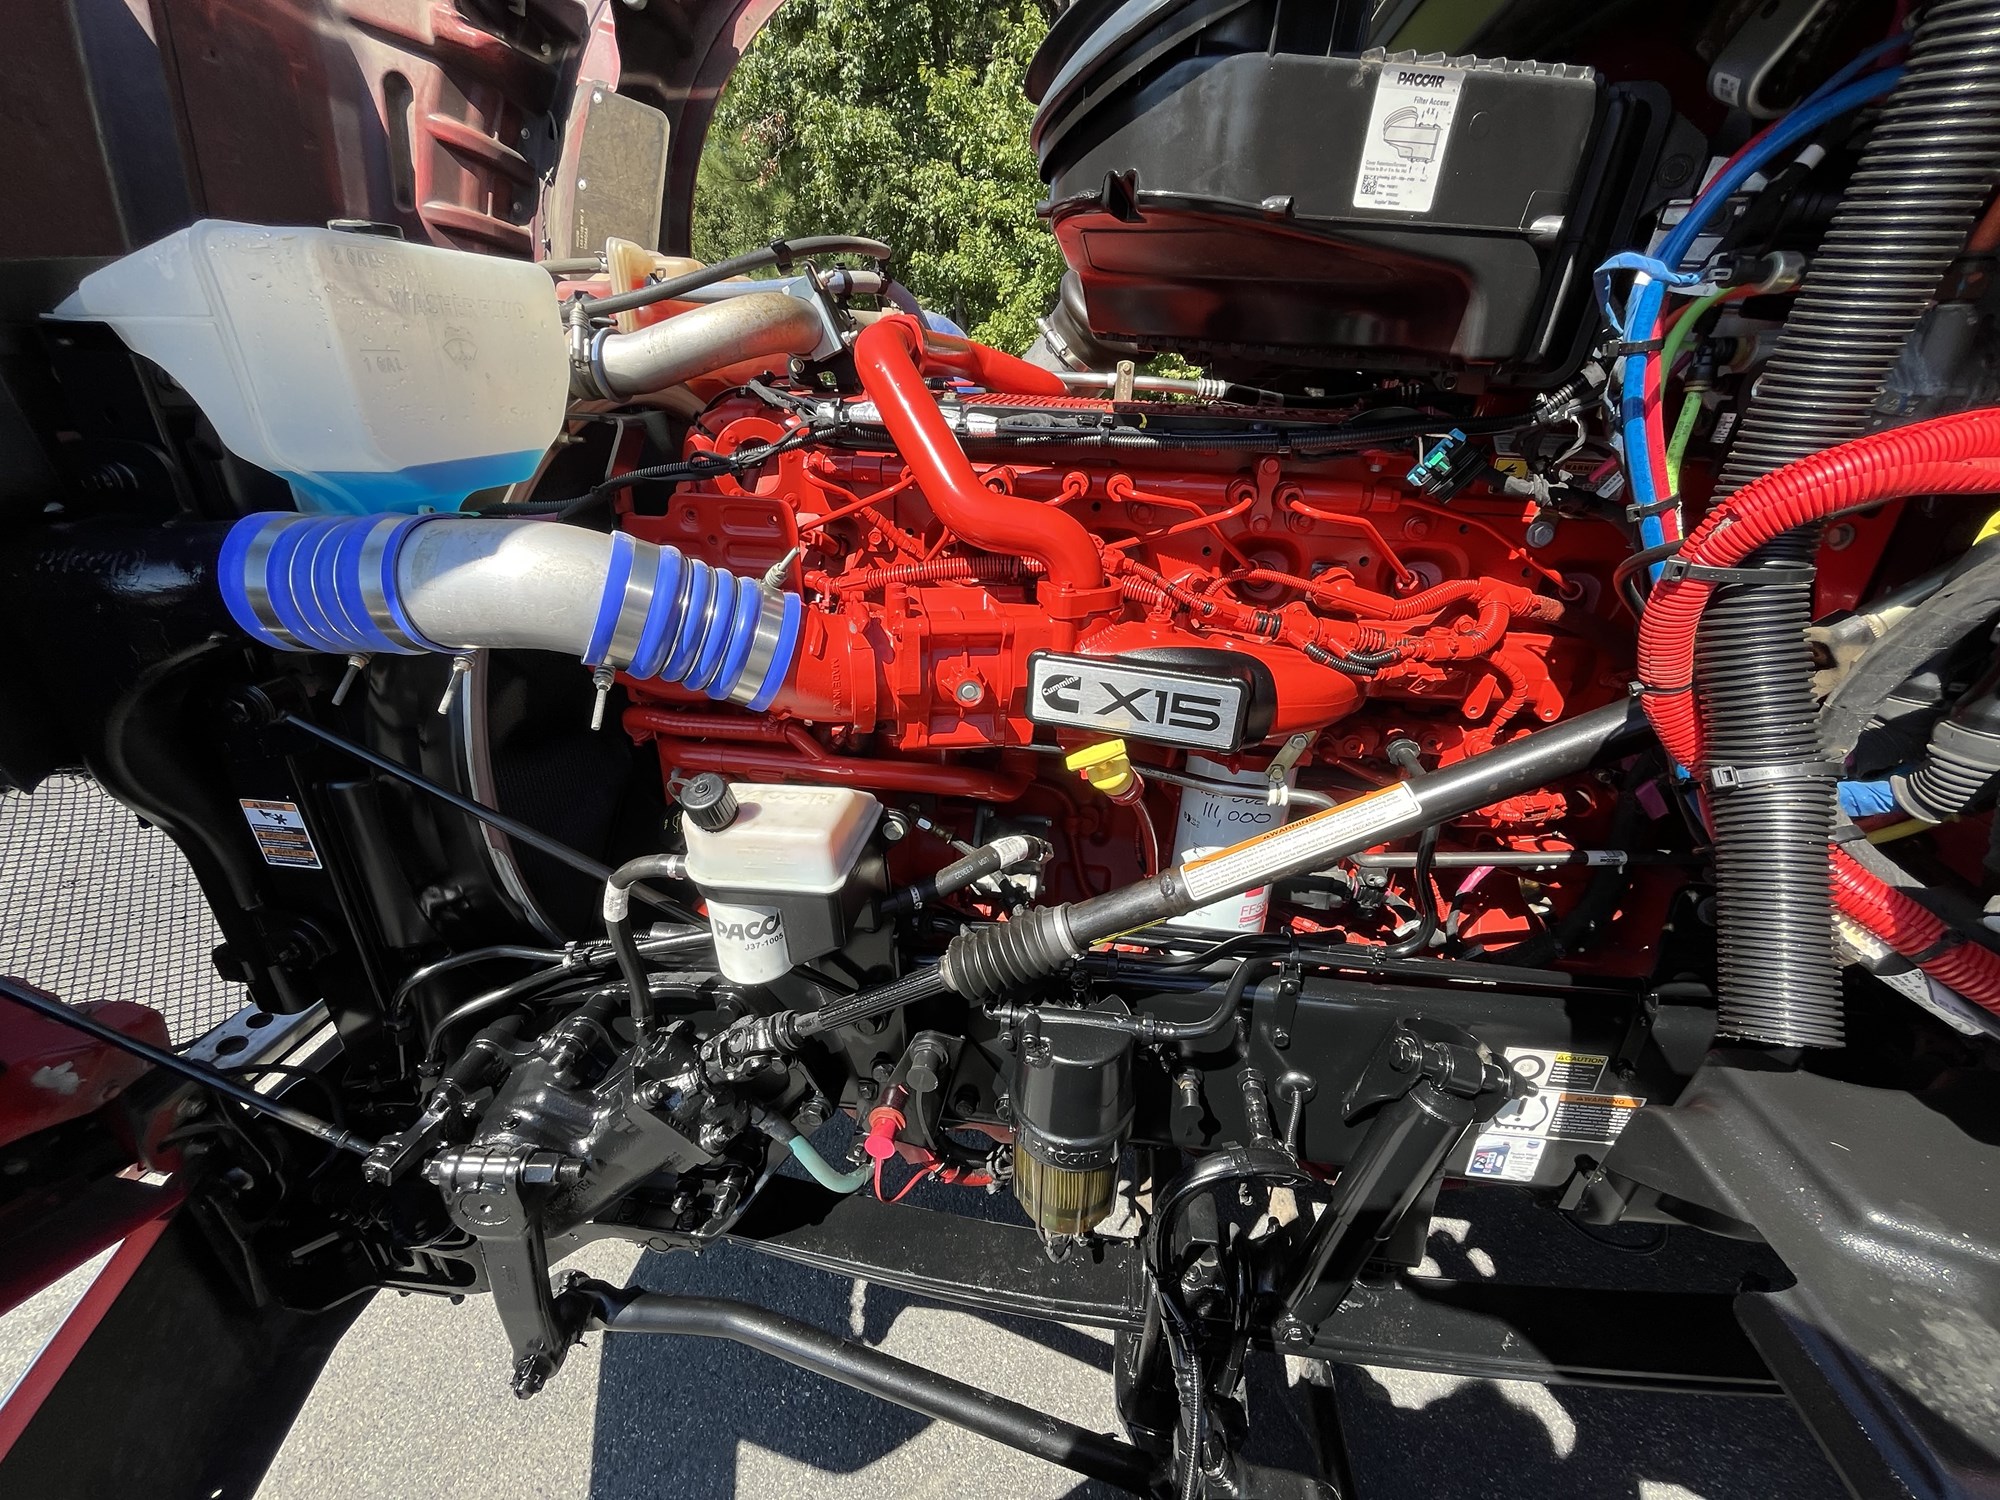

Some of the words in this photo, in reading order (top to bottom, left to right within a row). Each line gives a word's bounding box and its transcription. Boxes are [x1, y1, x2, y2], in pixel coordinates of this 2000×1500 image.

[1397, 71, 1445, 88] PACCAR
[1413, 96, 1429, 105] Filter
[1429, 97, 1450, 107] Access
[388, 289, 478, 318] WASHER
[1042, 676, 1080, 697] Cummins
[1094, 681, 1222, 732] X15
[1268, 816, 1317, 838] WARNING
[744, 932, 785, 951] J37-1005
[1564, 1055, 1606, 1064] CAUTION
[1583, 1097, 1625, 1105] WARNING
